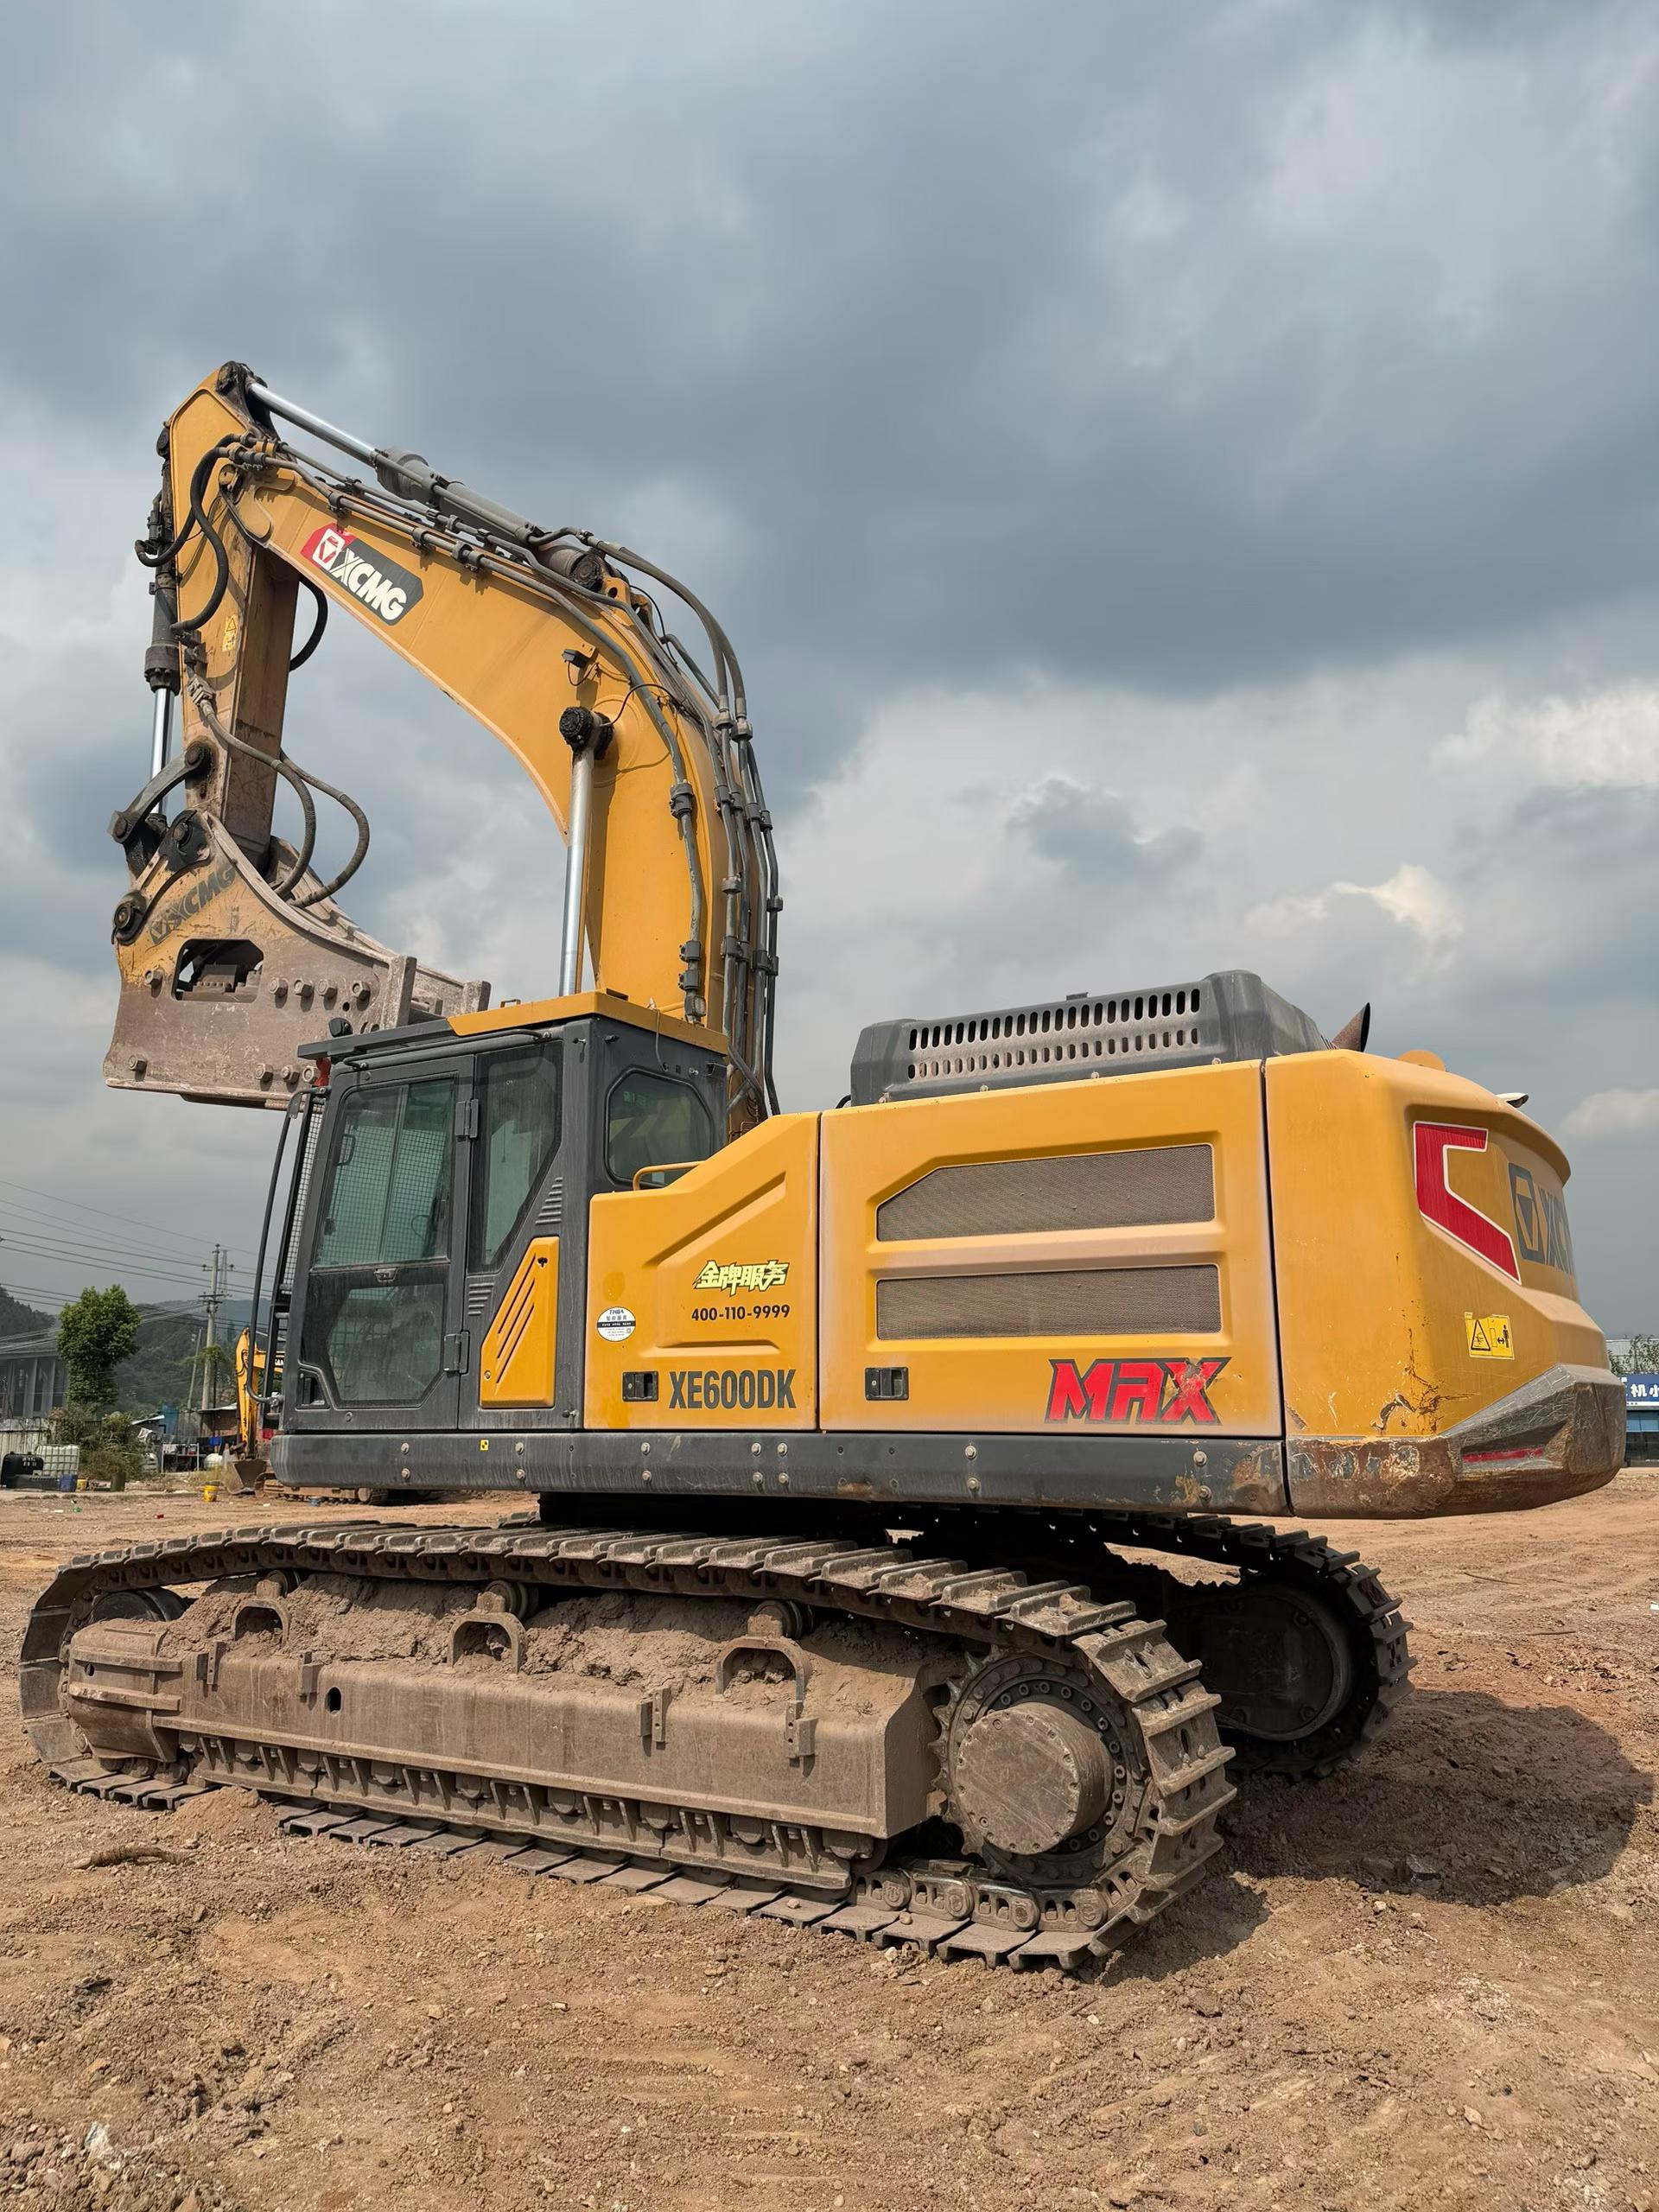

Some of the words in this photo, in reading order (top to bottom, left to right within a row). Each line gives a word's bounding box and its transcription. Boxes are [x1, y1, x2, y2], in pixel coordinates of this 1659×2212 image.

[328, 548, 407, 620] XCMG
[166, 862, 236, 930] XCMG
[692, 1260, 790, 1296] 金牌服务
[691, 1305, 790, 1321] 400-110-9999
[669, 1369, 797, 1409] XE600DK
[1045, 1357, 1232, 1426] MAX
[1626, 1383, 1659, 1398] 机小
